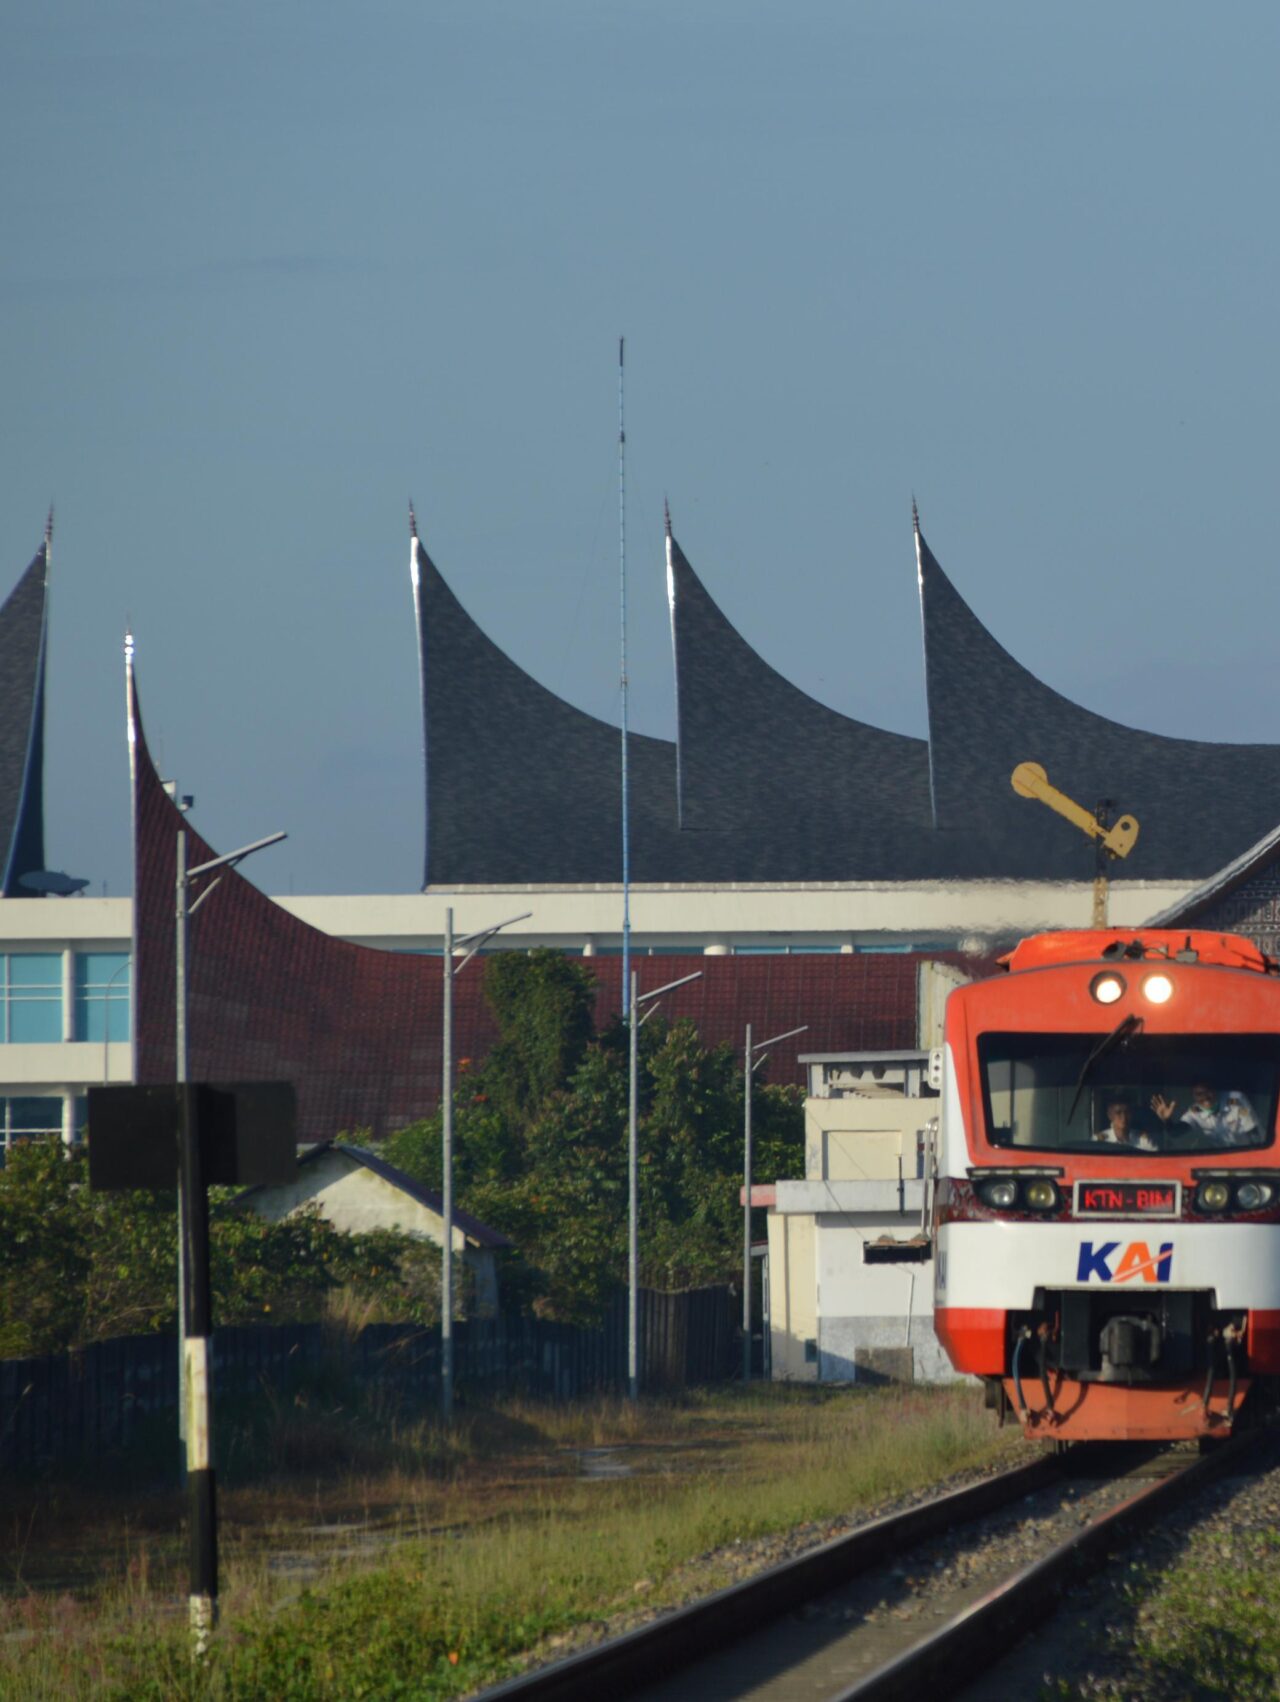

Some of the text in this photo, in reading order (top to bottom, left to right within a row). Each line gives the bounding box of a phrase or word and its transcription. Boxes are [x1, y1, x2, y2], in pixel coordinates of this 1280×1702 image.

[1084, 1188, 1123, 1209] KTN
[1136, 1188, 1174, 1209] BIM
[1077, 1241, 1174, 1282] KAI
